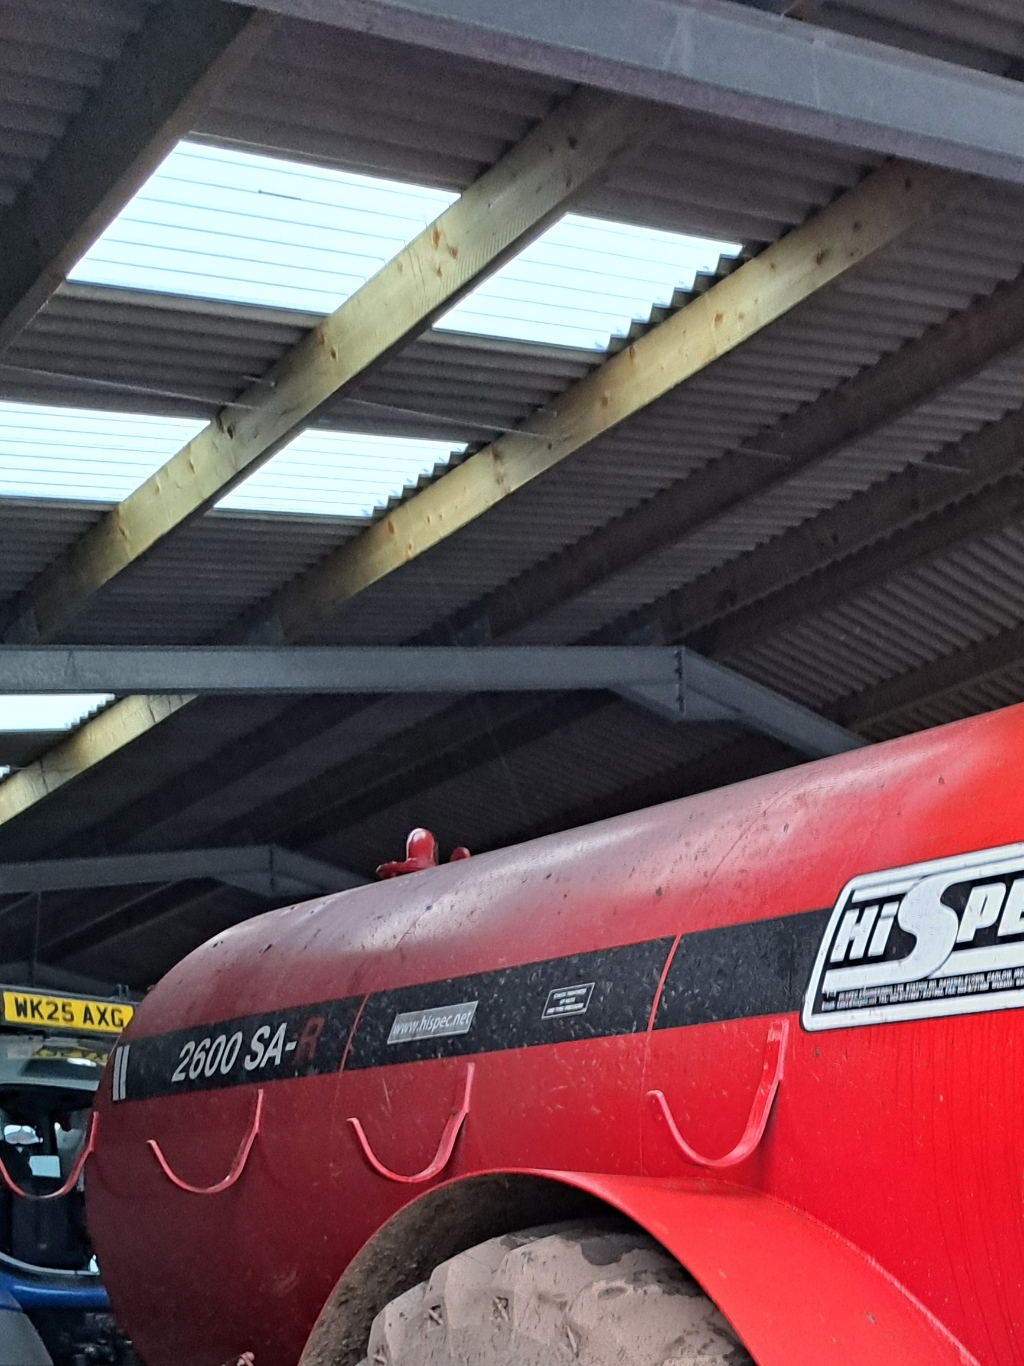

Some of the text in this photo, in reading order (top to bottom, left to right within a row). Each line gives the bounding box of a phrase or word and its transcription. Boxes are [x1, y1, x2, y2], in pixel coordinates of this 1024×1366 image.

[14, 997, 124, 1027] WK25 AXG
[392, 1010, 473, 1035] www.hispec.net
[171, 1031, 243, 1082] 2600
